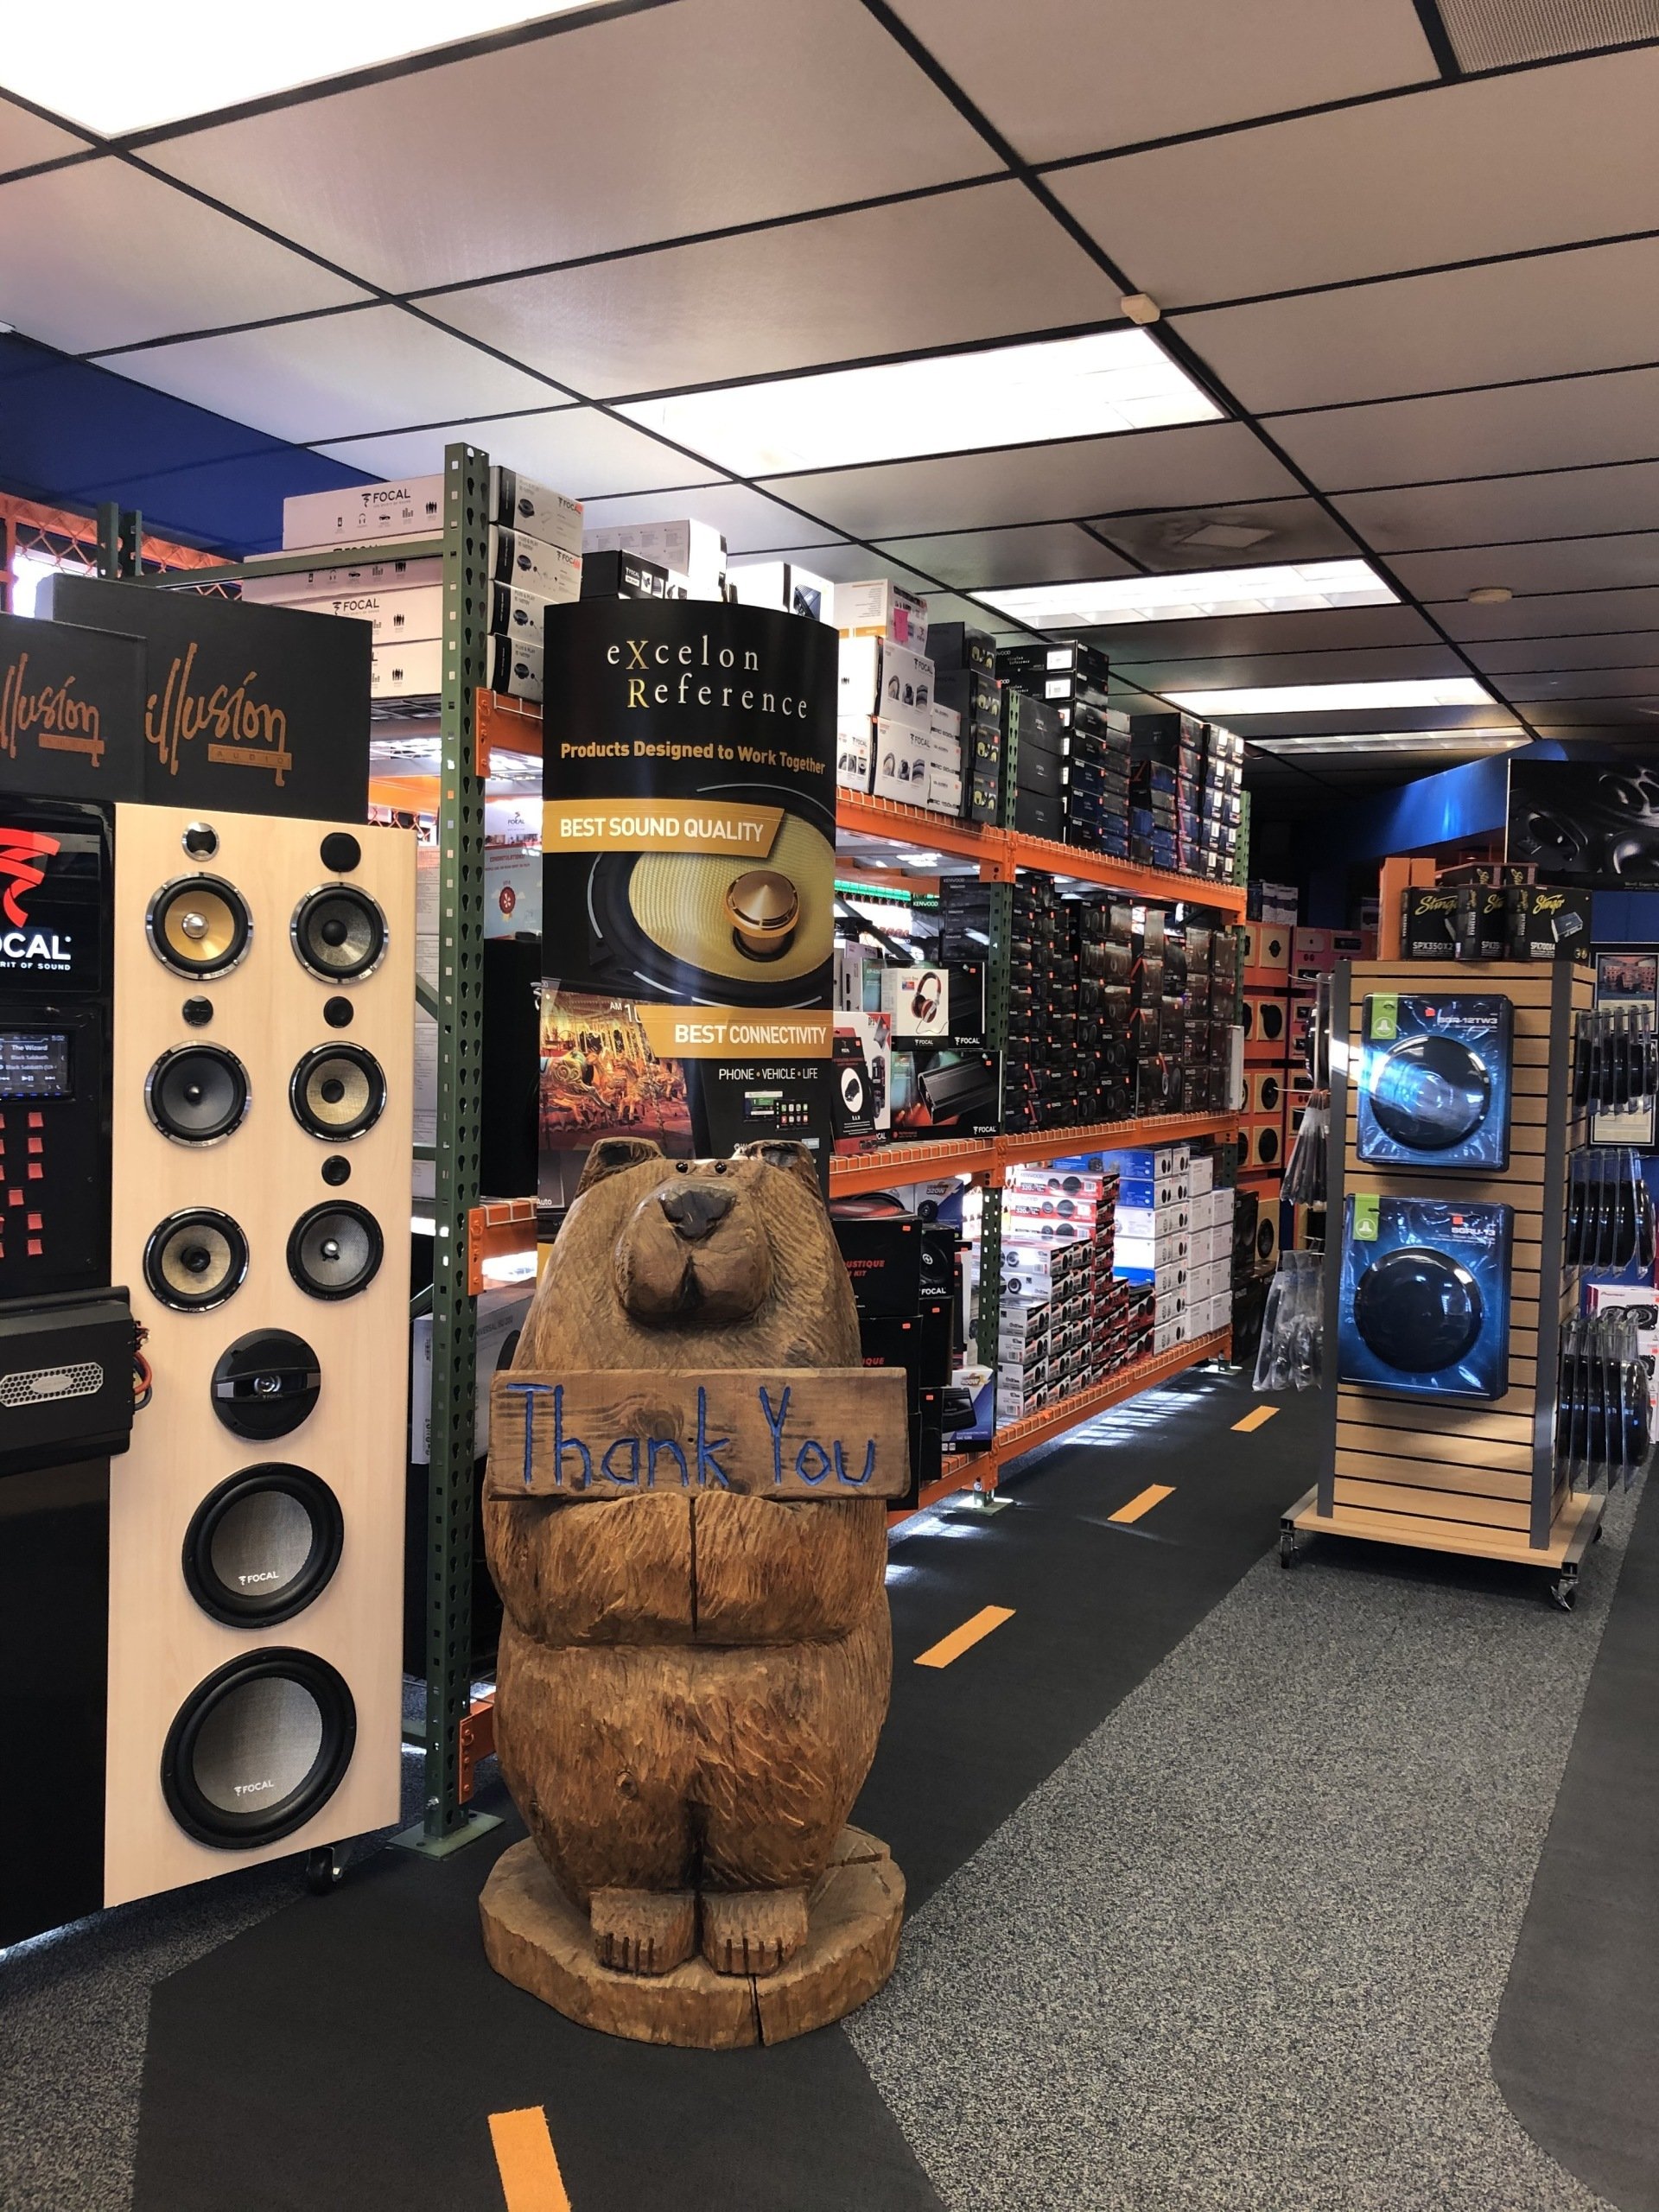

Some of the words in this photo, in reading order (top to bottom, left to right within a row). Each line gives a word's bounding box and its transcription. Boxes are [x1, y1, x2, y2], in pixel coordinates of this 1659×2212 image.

[372, 488, 411, 504] FOCAL
[343, 598, 380, 612] FOCAL
[607, 635, 759, 671] eXcelon
[918, 660, 934, 675] FOCAL
[626, 673, 807, 719] Reference
[0, 652, 101, 767] llusion
[915, 735, 931, 748] FOCAL
[561, 741, 630, 759] Products
[633, 741, 714, 761] Designed
[718, 744, 734, 760] to
[737, 745, 777, 766] Work
[779, 751, 826, 775] Together
[561, 817, 607, 838] BEST
[608, 817, 680, 838] SOUND
[683, 819, 764, 842] QUALITY
[0, 932, 71, 961] CAL
[1412, 941, 1453, 950] SPX350X2
[37, 963, 71, 971] SOUND
[609, 1001, 623, 1011] AM
[675, 1024, 727, 1044] BEST
[729, 1026, 827, 1045] CONNECTIVITY
[719, 1068, 754, 1080] PHONE
[762, 1067, 796, 1079] VEHICLE
[803, 1068, 818, 1079] LIFE
[844, 1260, 885, 1268] USTIQUE
[506, 1383, 730, 1487] Thank
[759, 1385, 876, 1487] You
[247, 1571, 279, 1584] FOCAL
[242, 1780, 274, 1794] FOCAL
